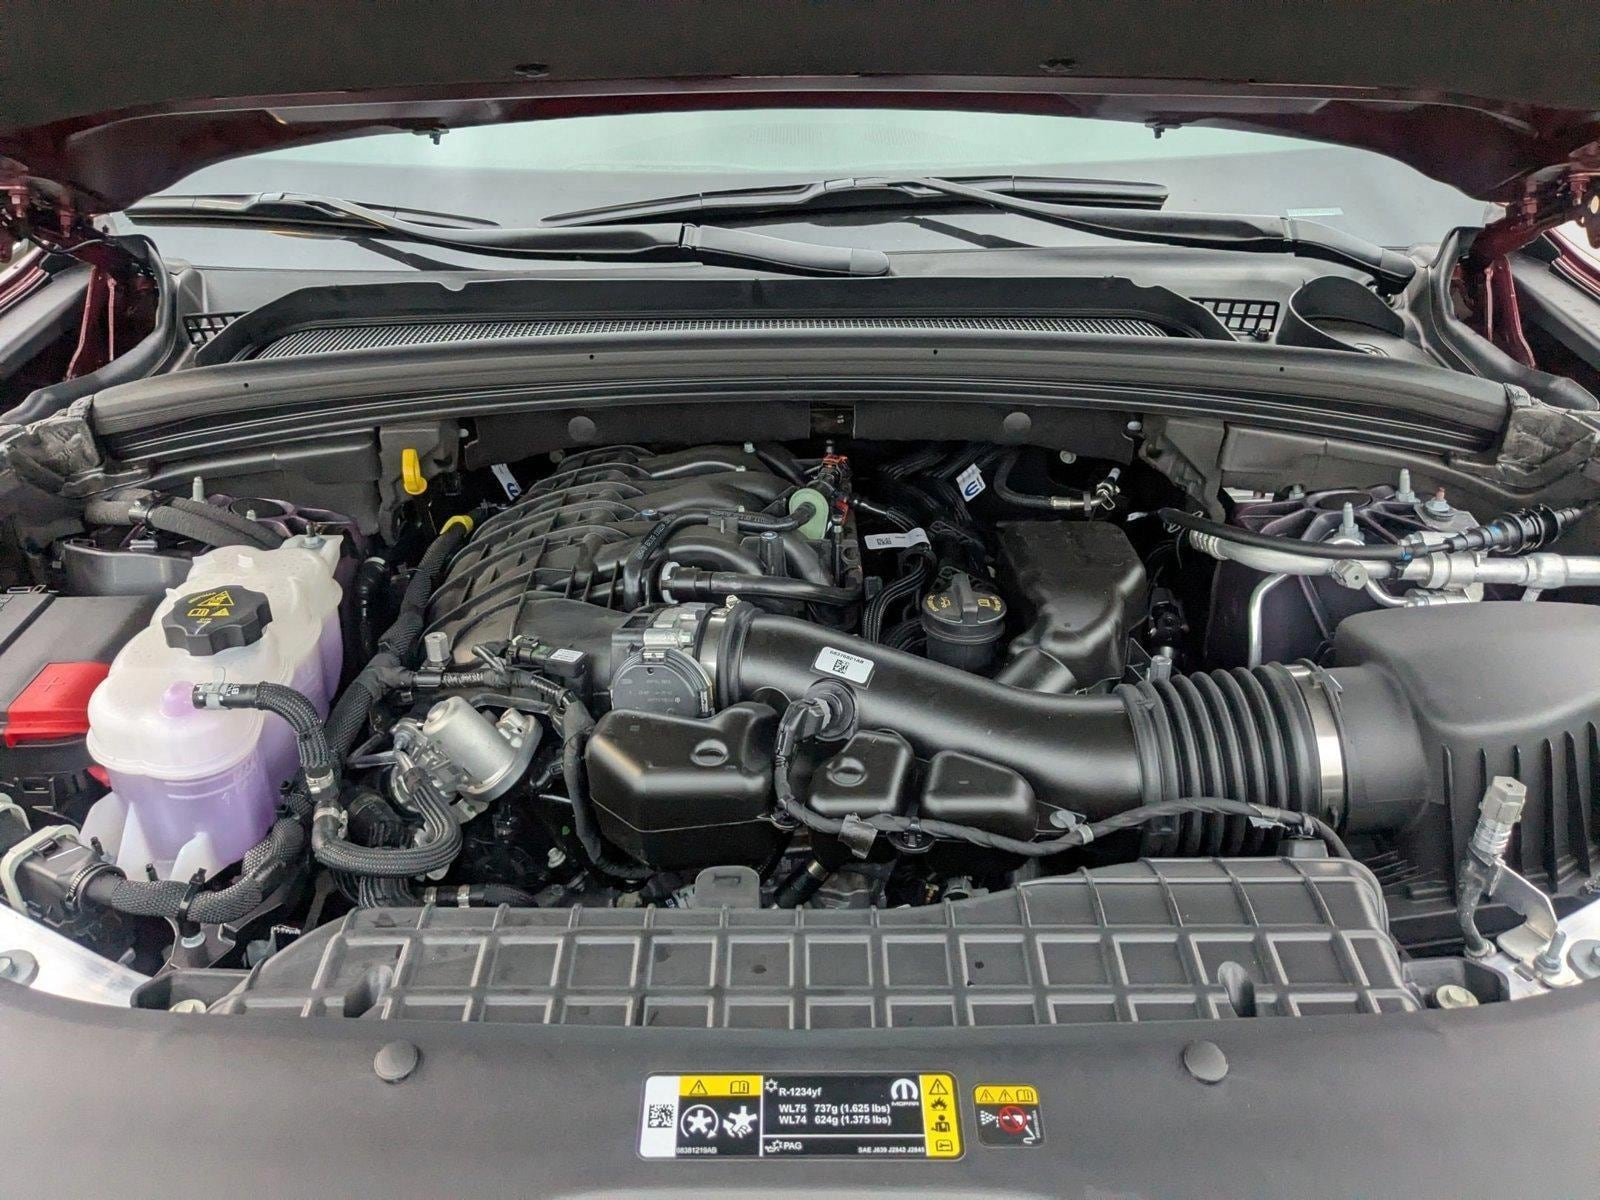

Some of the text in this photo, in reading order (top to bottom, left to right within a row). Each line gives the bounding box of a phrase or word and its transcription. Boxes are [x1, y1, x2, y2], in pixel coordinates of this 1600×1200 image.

[779, 1087, 822, 1098] R-1234yf
[779, 1104, 890, 1115] WL75 737g (1.625 lbs)
[779, 1115, 891, 1125] WL74 624g (1.375 lbs)
[784, 1142, 802, 1150] PAG
